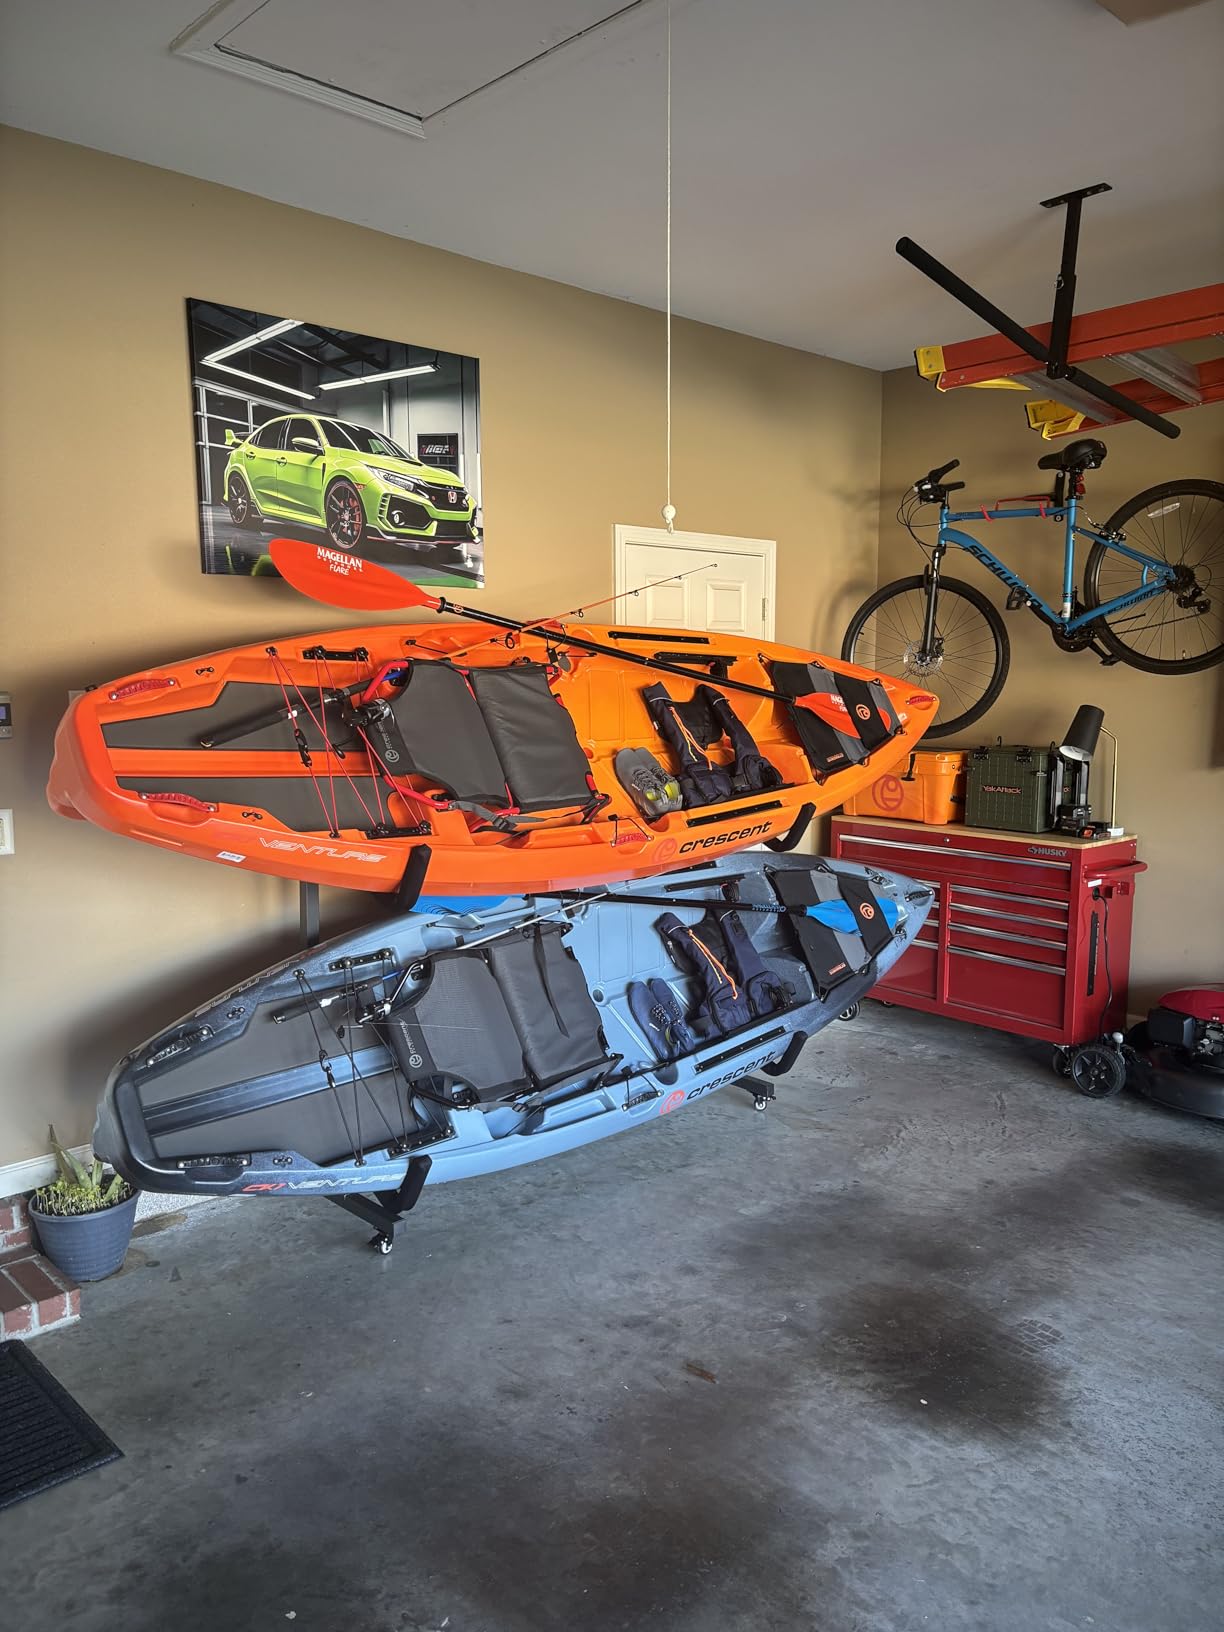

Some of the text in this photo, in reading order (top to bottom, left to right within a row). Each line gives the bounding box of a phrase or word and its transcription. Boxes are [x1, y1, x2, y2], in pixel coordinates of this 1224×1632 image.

[316, 545, 363, 569] MAGELLAN
[968, 544, 1043, 609] SCHWN
[982, 785, 1022, 795] YakAttack
[258, 837, 388, 863] VENTURE
[679, 820, 773, 854] crescent
[1039, 846, 1068, 857] HUSKY
[686, 1050, 777, 1101] crescent
